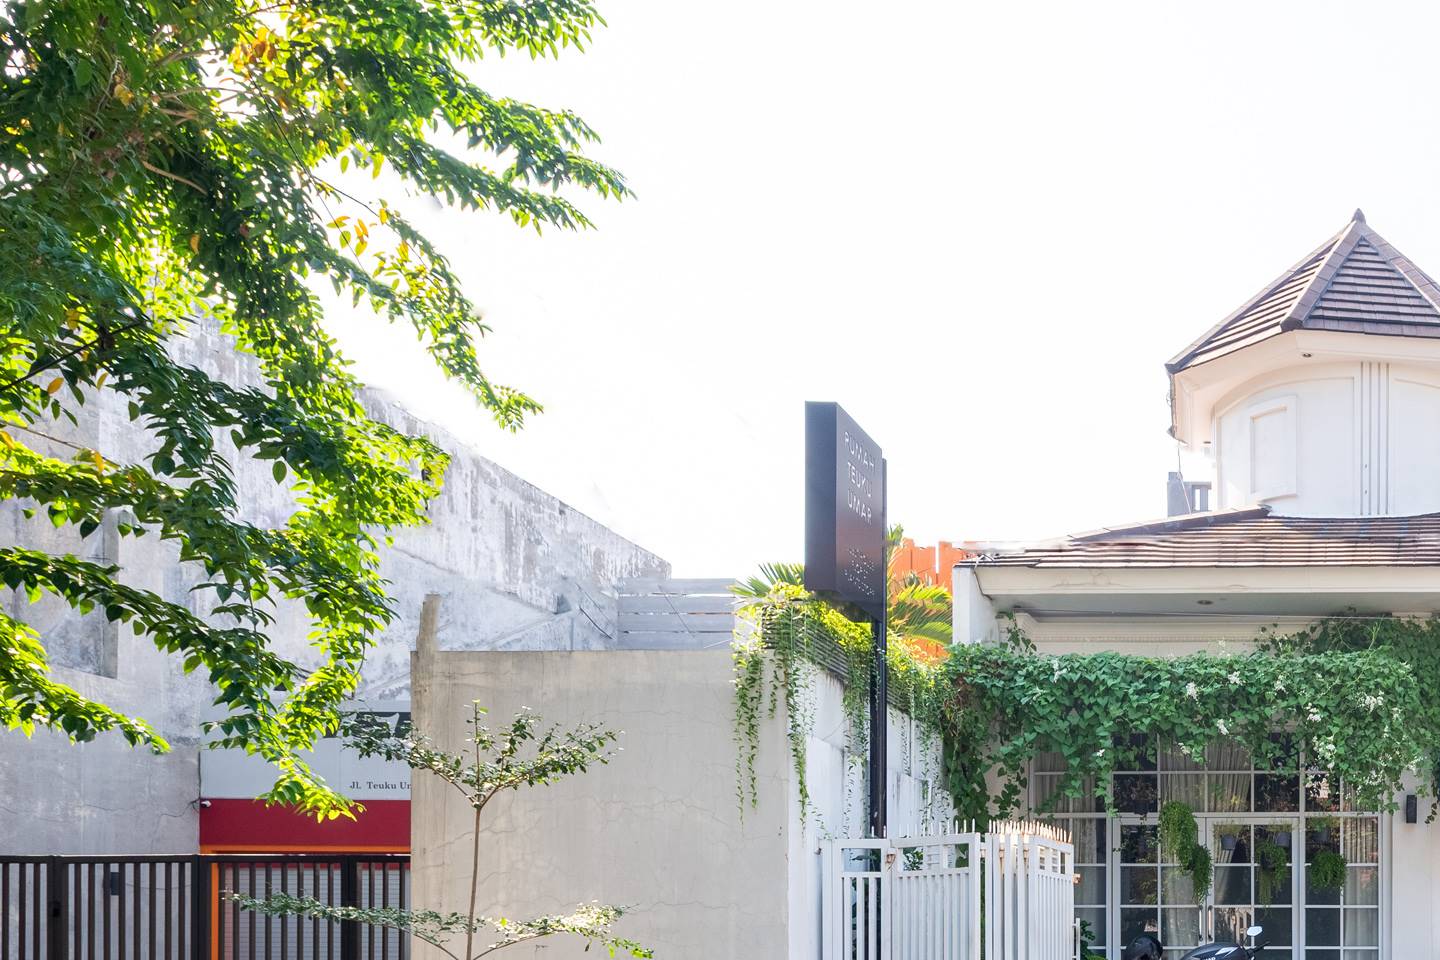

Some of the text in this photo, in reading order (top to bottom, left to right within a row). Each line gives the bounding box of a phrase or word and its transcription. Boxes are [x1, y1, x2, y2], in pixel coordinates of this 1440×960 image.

[844, 431, 876, 475] RUMAH
[847, 461, 873, 498] TEUKU
[847, 487, 873, 526] UMAR
[366, 781, 397, 790] Teuku
